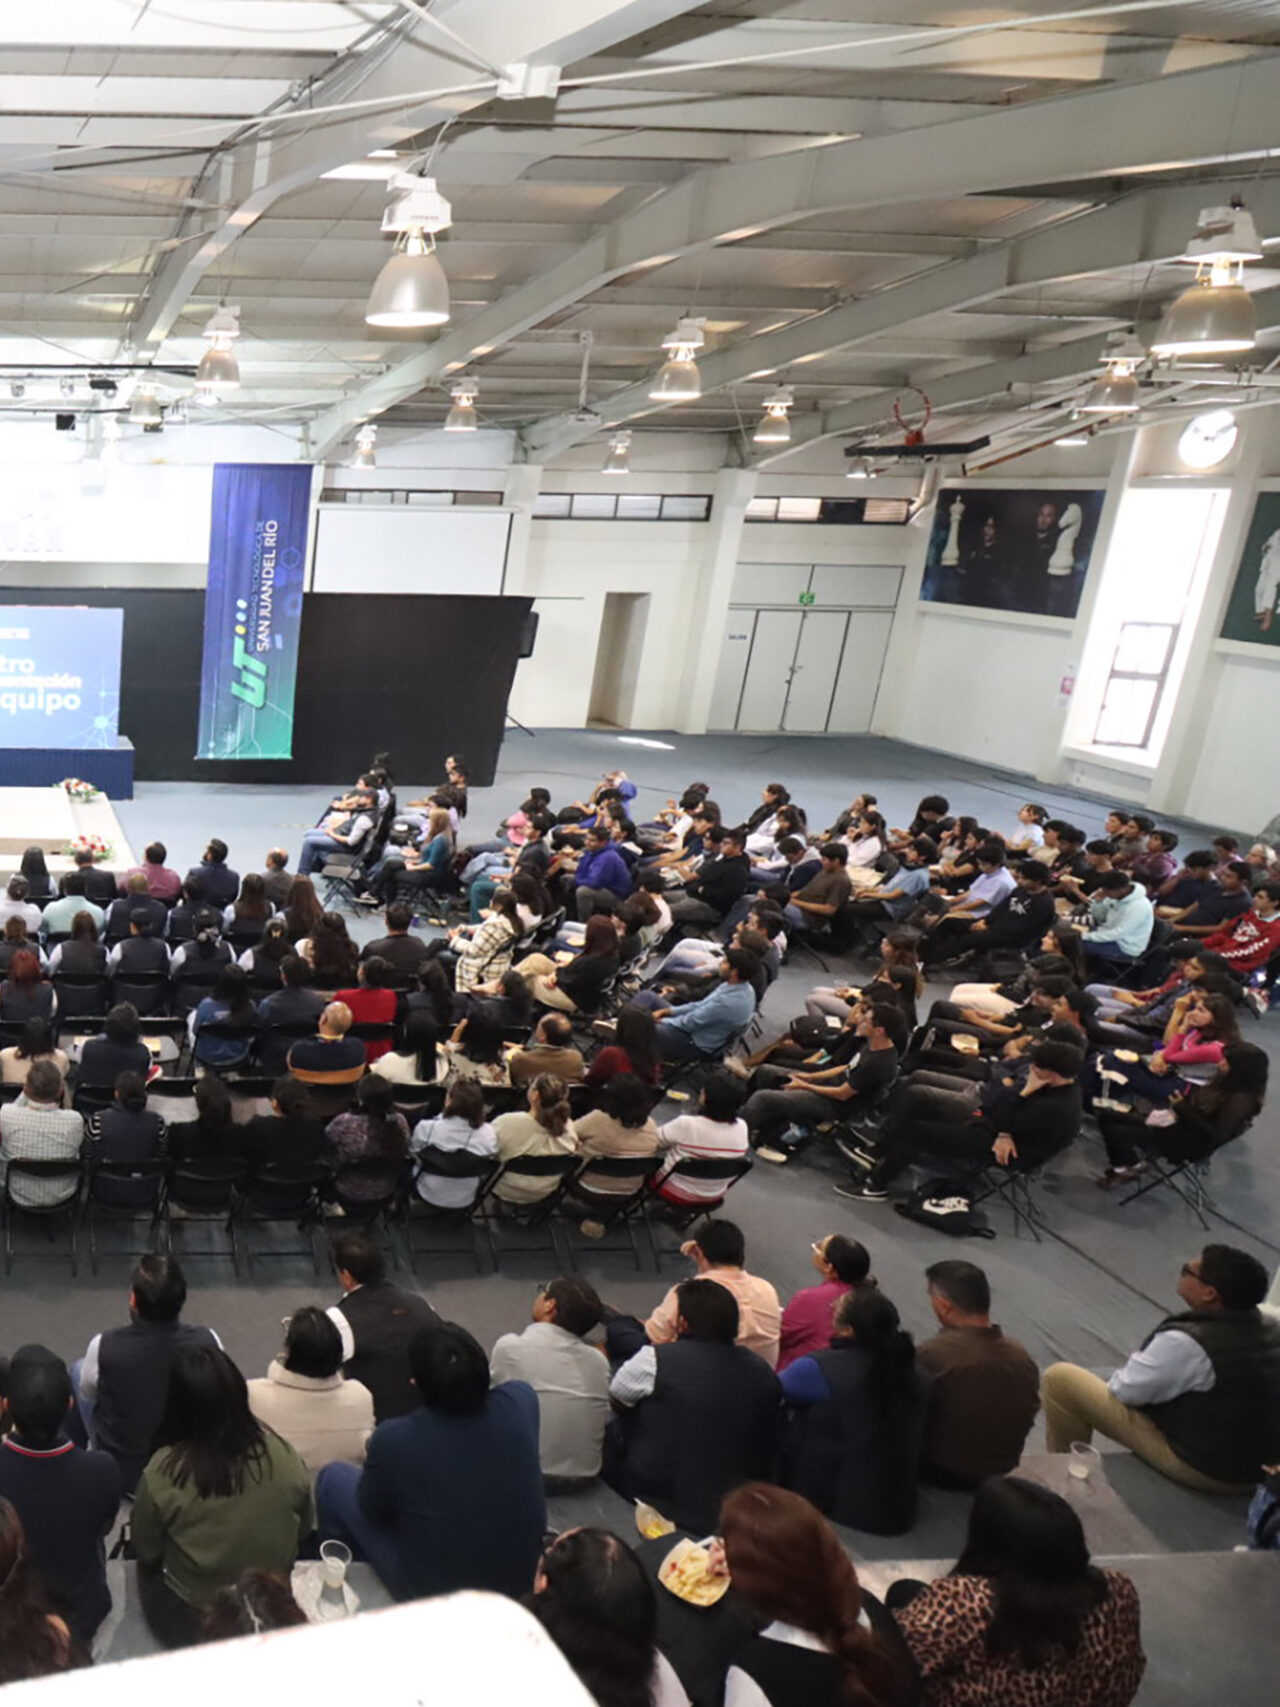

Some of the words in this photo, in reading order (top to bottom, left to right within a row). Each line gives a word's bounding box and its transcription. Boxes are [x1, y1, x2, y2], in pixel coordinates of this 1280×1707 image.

[262, 520, 278, 546] RÍO
[261, 549, 276, 579] DEL
[259, 580, 274, 618] JUAN
[256, 620, 270, 652] SAN
